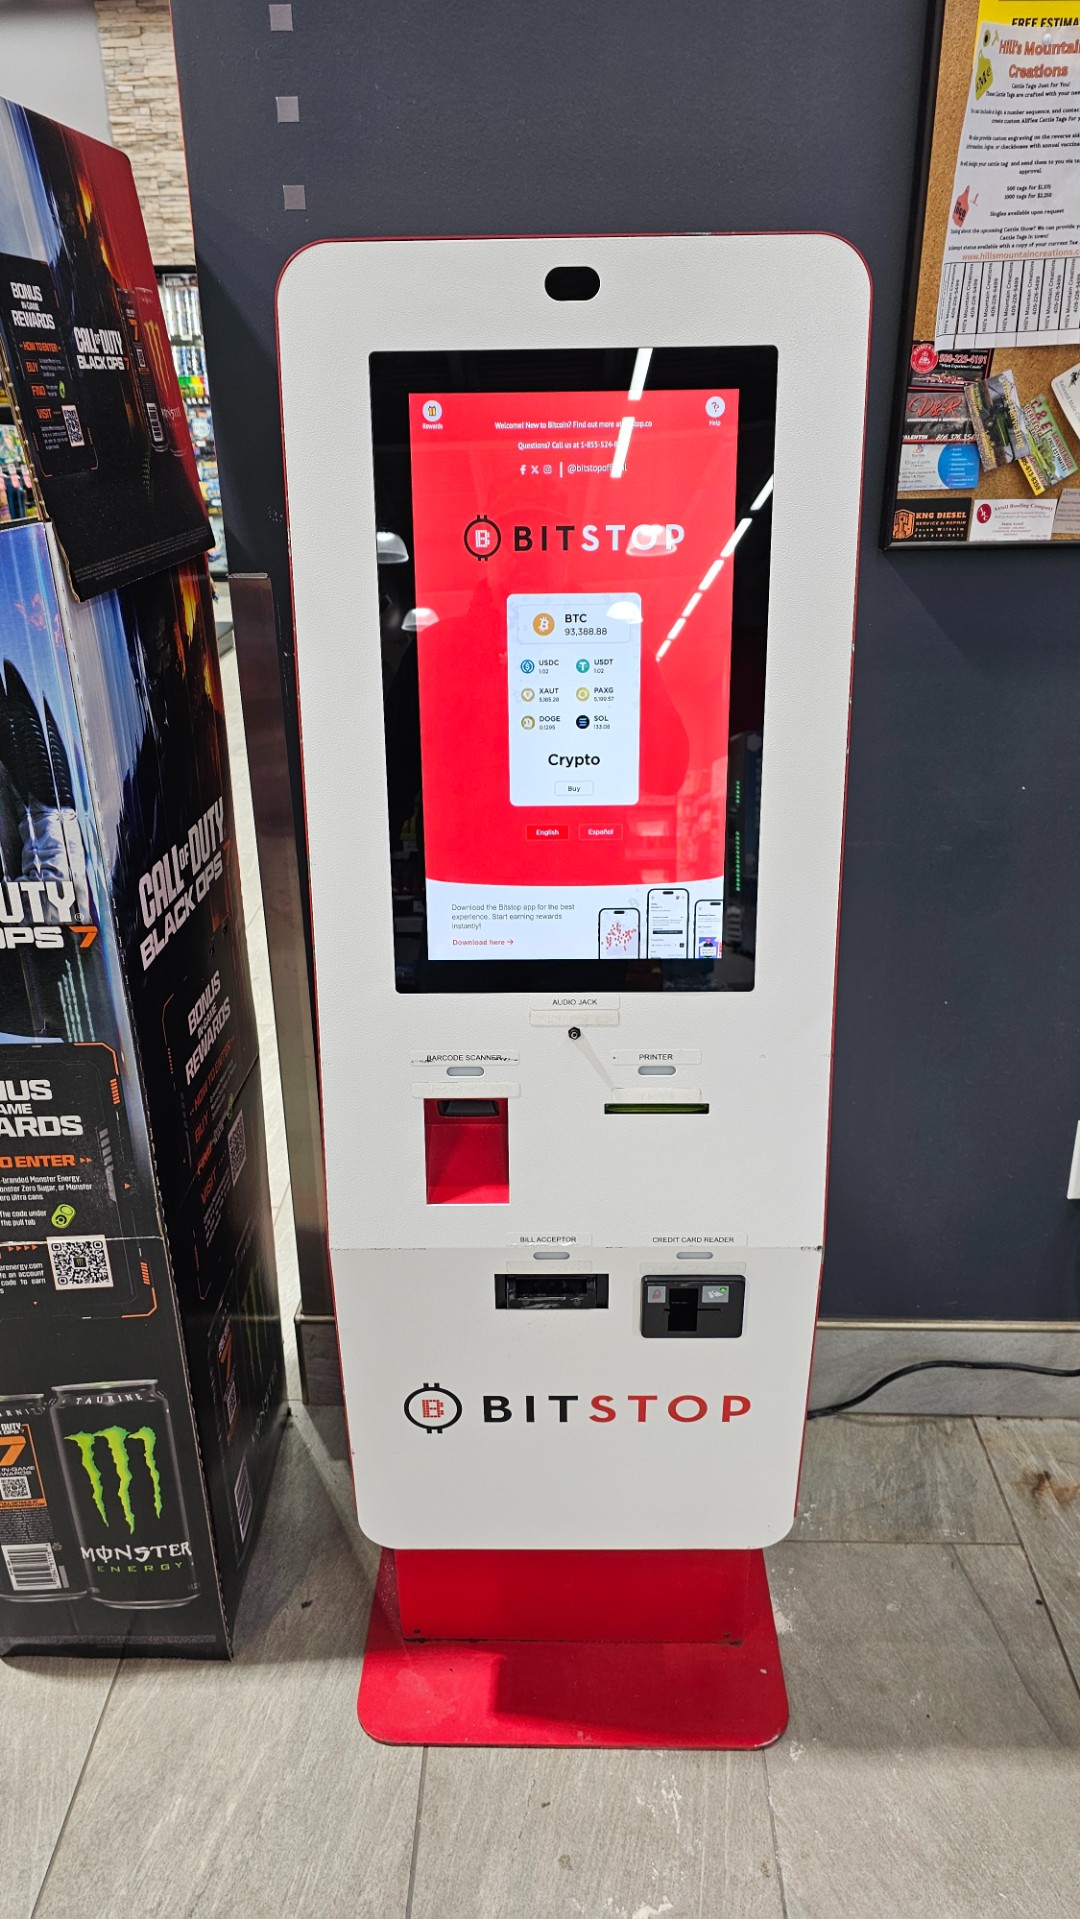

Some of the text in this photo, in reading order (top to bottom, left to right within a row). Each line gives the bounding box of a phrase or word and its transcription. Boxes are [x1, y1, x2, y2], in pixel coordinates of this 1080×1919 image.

[1041, 17, 1080, 27] ESTIMA
[1024, 39, 1080, 56] Mountai
[1008, 64, 1068, 78] Creations
[10, 282, 43, 302] BONUS
[11, 310, 56, 330] REWARDS
[74, 326, 96, 354] CALL
[99, 328, 124, 354] DUTY
[76, 355, 108, 370] BLACK
[107, 356, 124, 370] OPS
[494, 421, 524, 429] Welcome!
[518, 442, 550, 450] Questions?
[568, 464, 627, 473] @bitstopoffl
[514, 524, 685, 552] BITSTOP
[565, 614, 587, 623] BTC
[548, 754, 600, 768] Crypto
[568, 784, 580, 793] Buy
[536, 828, 560, 837] English
[588, 828, 614, 837] Español
[138, 843, 186, 929] CALL
[188, 796, 225, 874] DUTY
[139, 854, 224, 971] BLACK OPS
[498, 904, 522, 912] Bitstop
[0, 926, 98, 949] PS 7
[188, 970, 220, 1036] BONUS
[552, 998, 598, 1006] AUDIO JACK
[185, 996, 232, 1086] REWARDS
[426, 1054, 502, 1062] BARCODE SCANNER
[638, 1053, 674, 1061] PRINTER
[14, 1154, 76, 1168] ENTER
[66, 1183, 92, 1191] Monster
[12, 1218, 24, 1226] pull
[76, 1392, 144, 1406] TAURINE
[483, 1394, 752, 1423] BITSTOP
[97, 1562, 184, 1573] ENERGY
